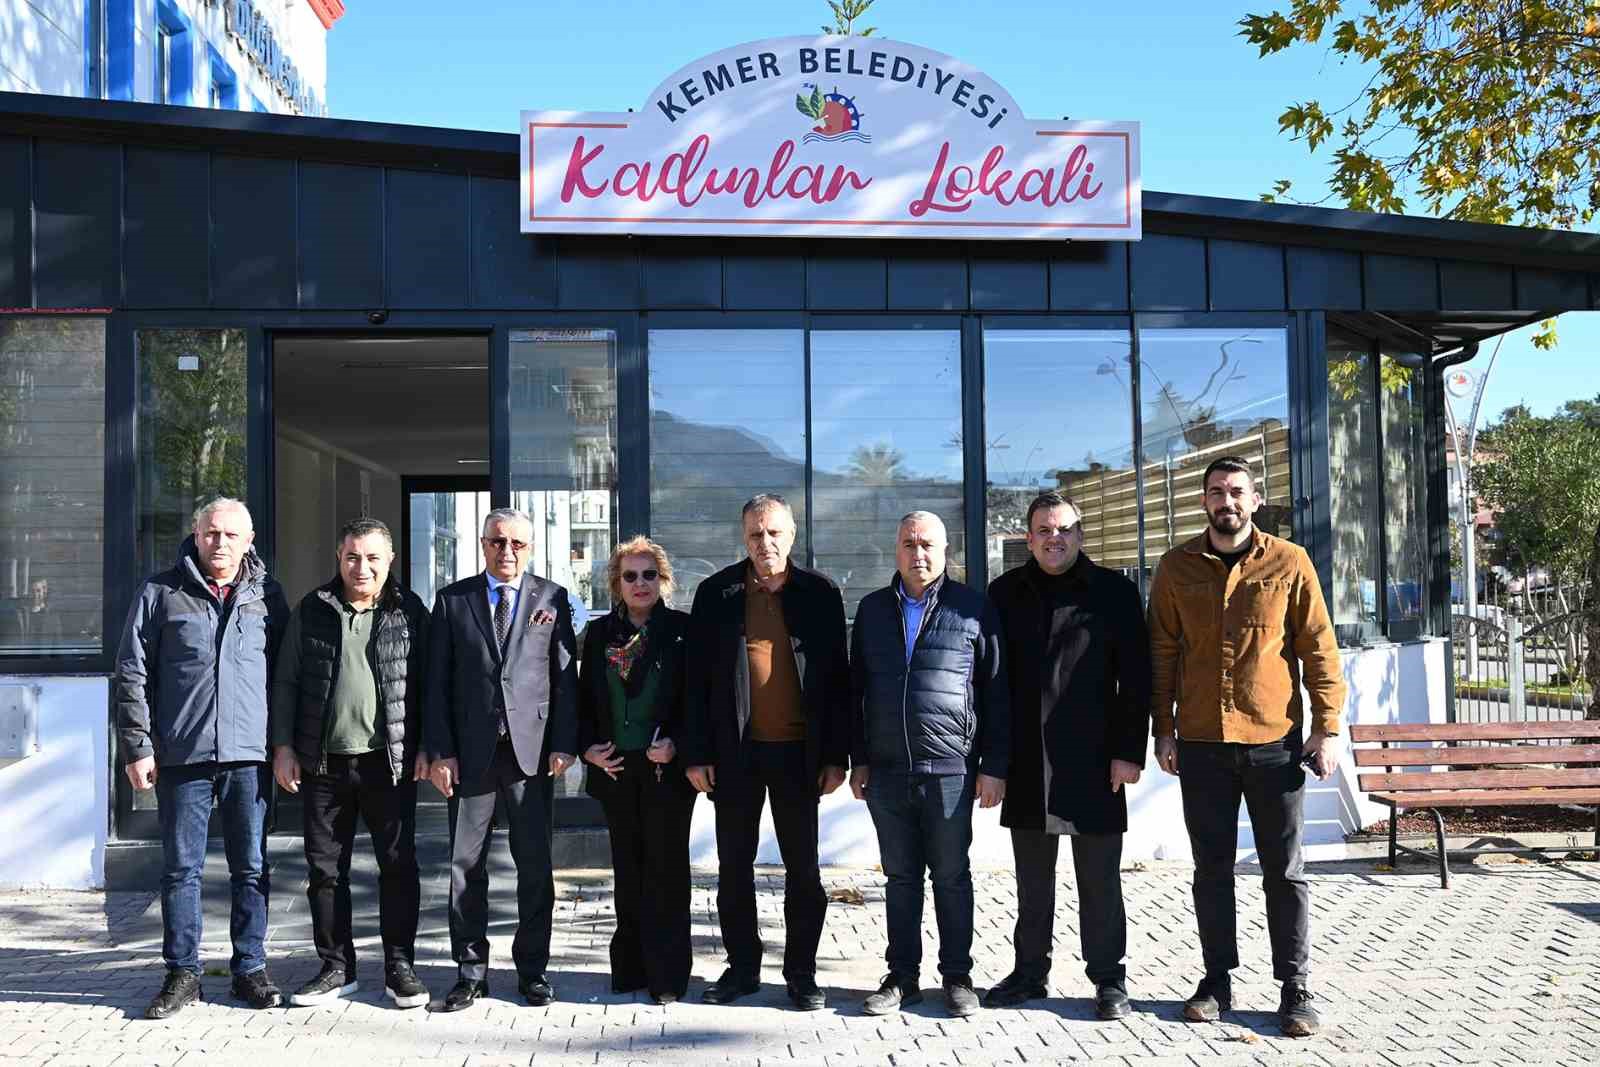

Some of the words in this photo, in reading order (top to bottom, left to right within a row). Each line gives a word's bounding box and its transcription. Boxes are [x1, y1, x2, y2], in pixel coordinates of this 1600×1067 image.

[656, 52, 781, 123] KEMER
[560, 134, 873, 208] Kadınlar
[909, 142, 1103, 217] Lokali
